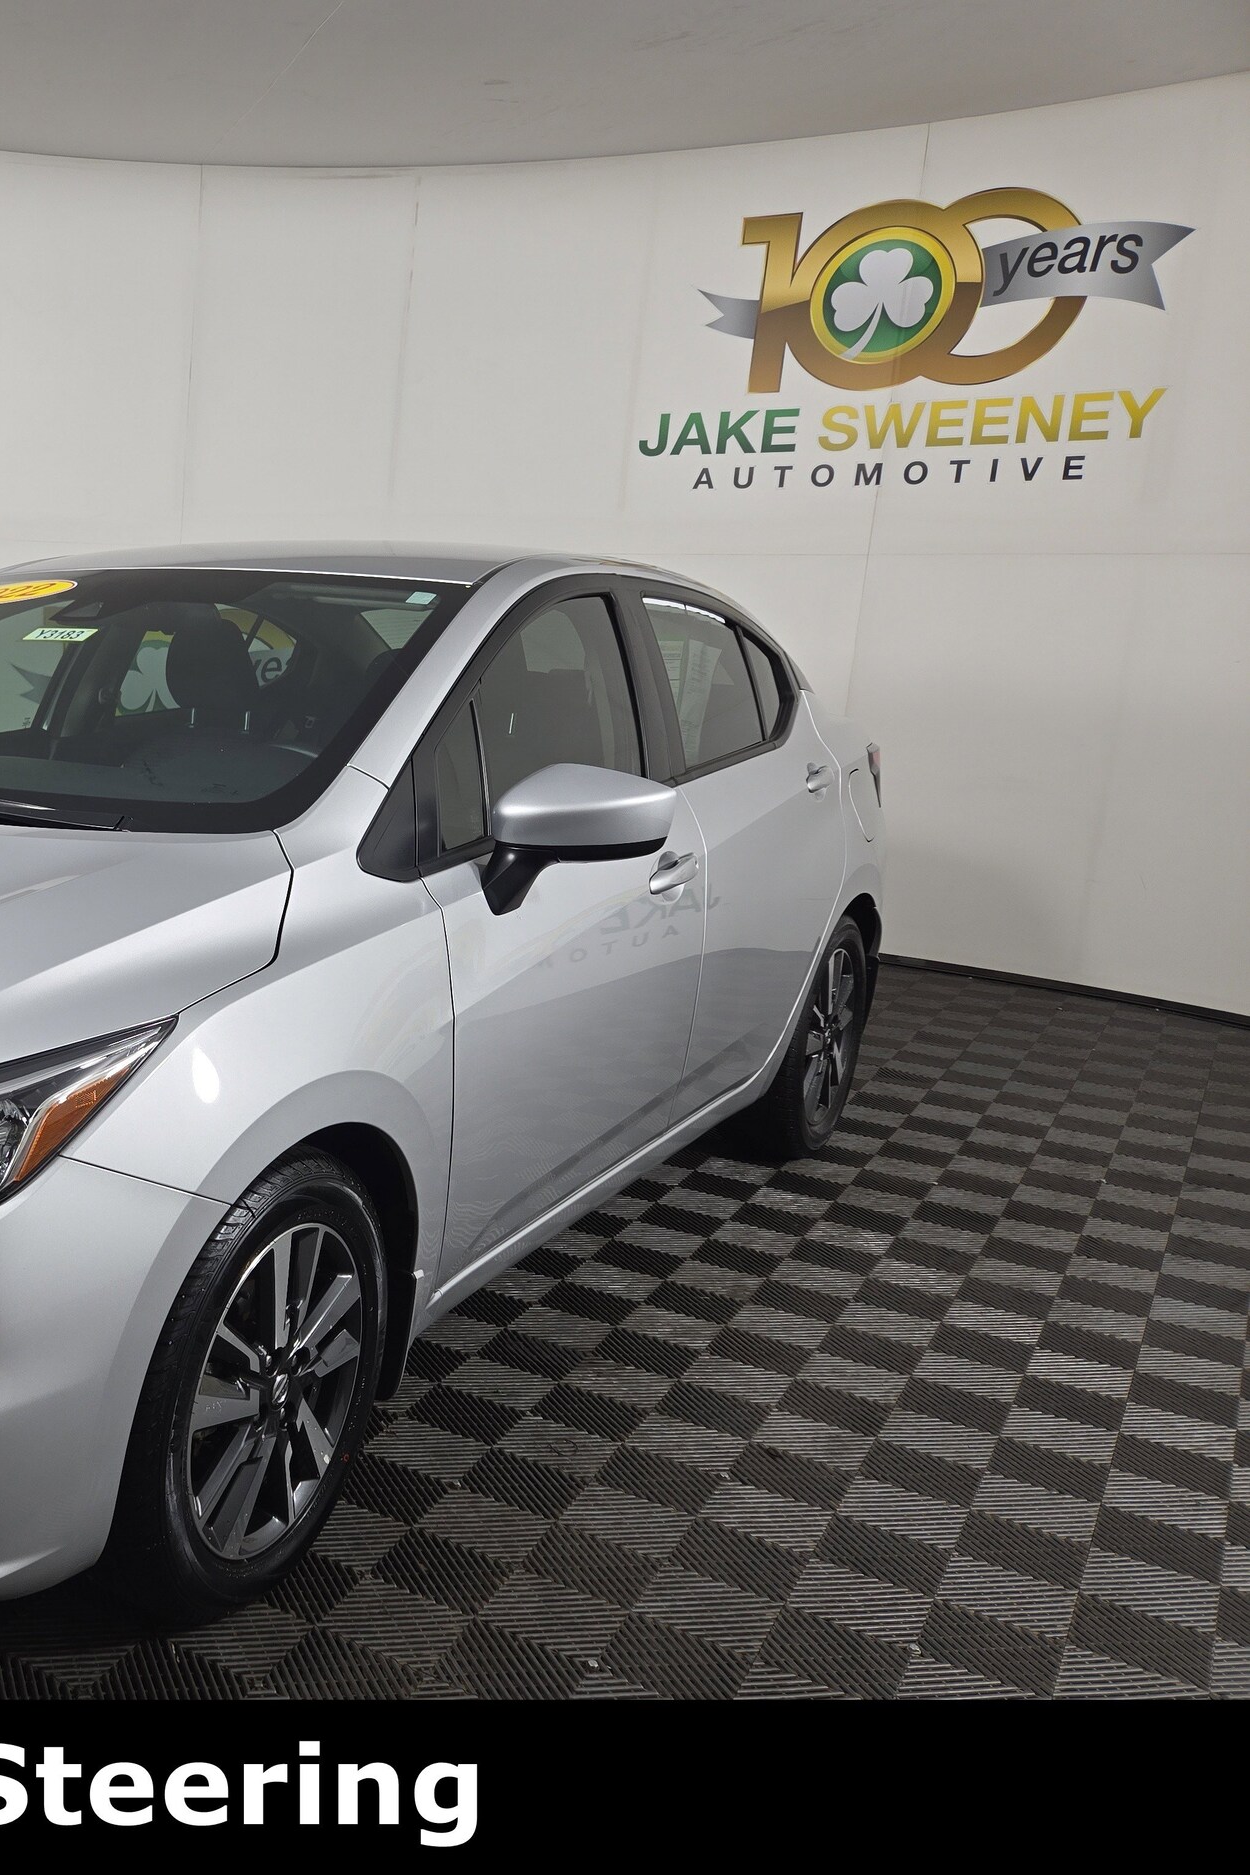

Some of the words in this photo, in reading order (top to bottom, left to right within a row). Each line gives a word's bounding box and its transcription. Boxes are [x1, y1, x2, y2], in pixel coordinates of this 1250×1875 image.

[992, 232, 1144, 297] years
[638, 407, 801, 457] JAKE
[816, 387, 1167, 452] SWEENEY
[692, 454, 1087, 490] AUTOMOTIVE
[35, 629, 86, 640] Y3183
